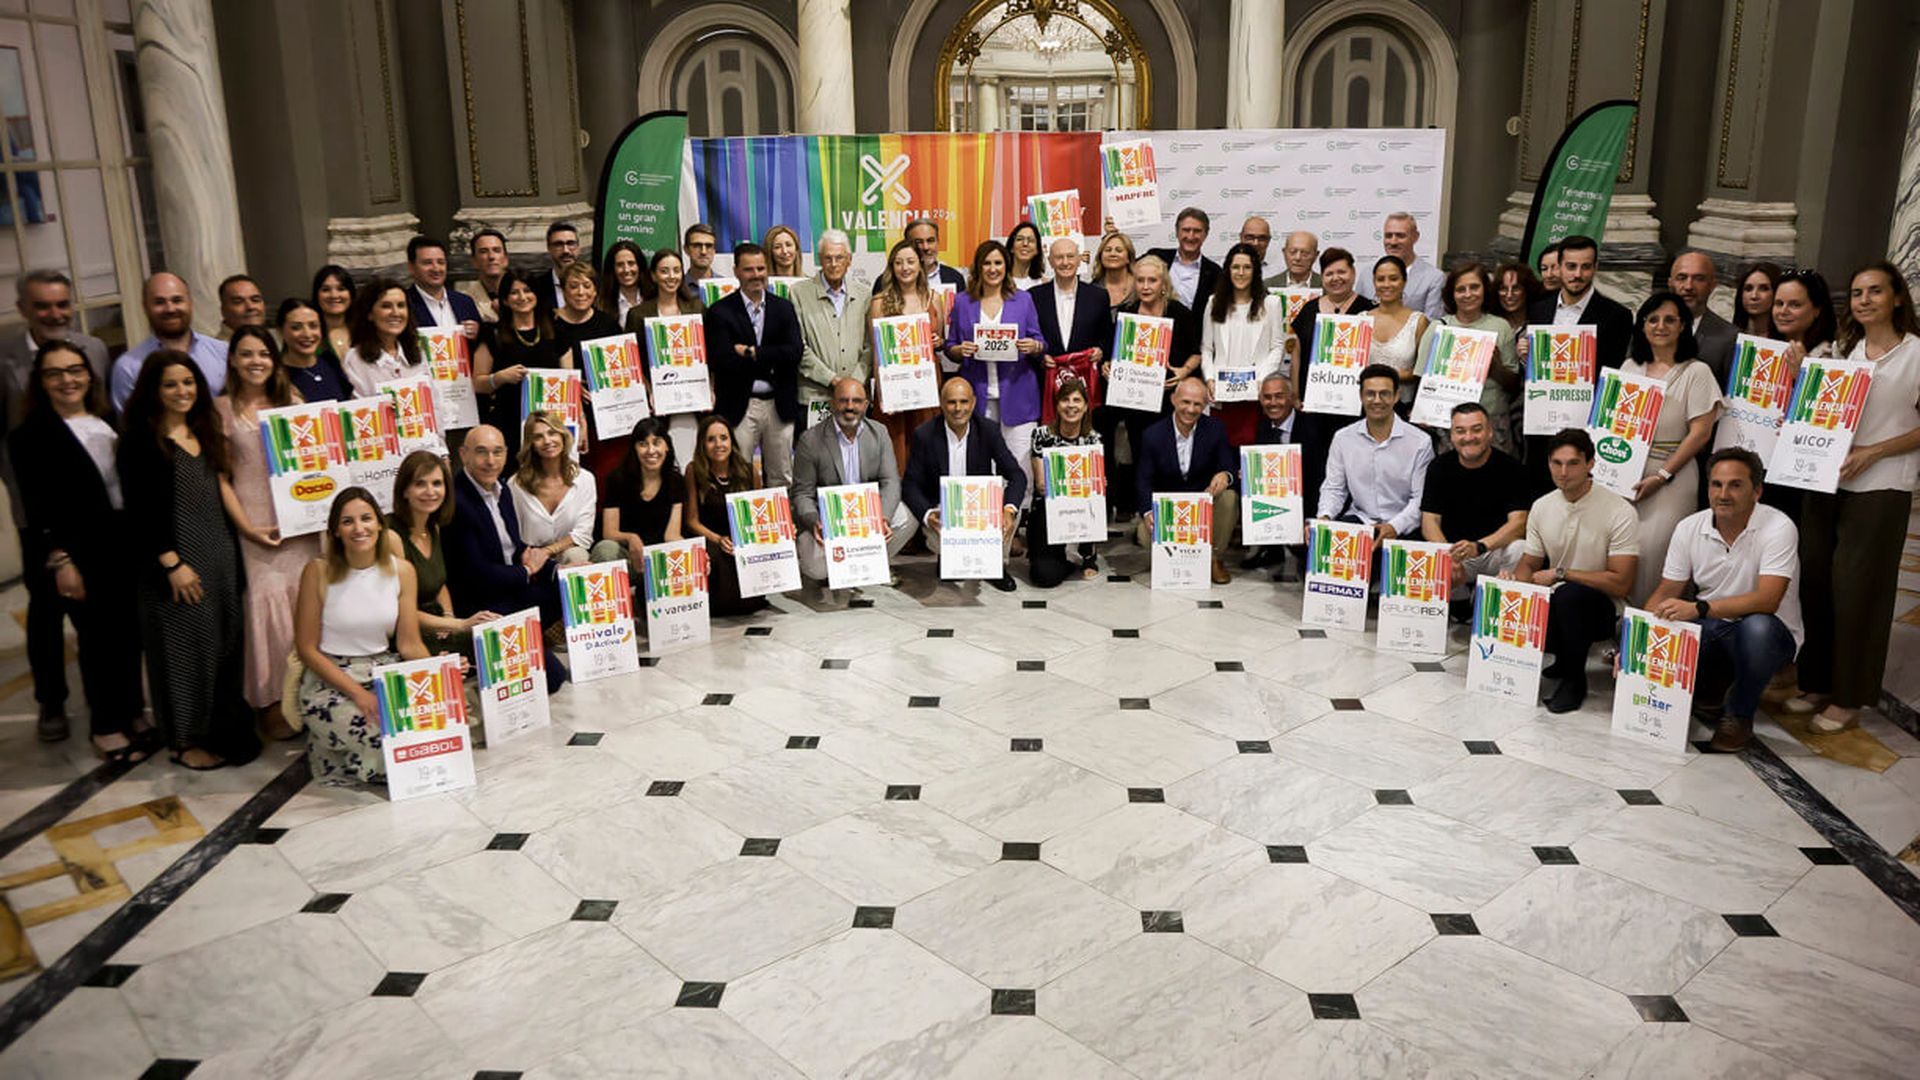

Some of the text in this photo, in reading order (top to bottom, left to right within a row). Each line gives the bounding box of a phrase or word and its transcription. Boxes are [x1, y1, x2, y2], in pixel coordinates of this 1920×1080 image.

[1115, 190, 1155, 202] MAPFRE
[618, 199, 666, 212] Tenemos
[618, 213, 657, 223] un gran
[841, 209, 931, 230] VALENCIA
[617, 224, 655, 235] camino
[984, 339, 1010, 351] 2025
[1226, 382, 1249, 392] 2025
[1804, 400, 1845, 415] VALENCIA
[1310, 583, 1363, 598] FERMAX
[664, 601, 704, 615] vareser
[570, 625, 625, 643] umivale
[1635, 651, 1677, 674] VALENCIA
[397, 700, 448, 719] VALENCIA
